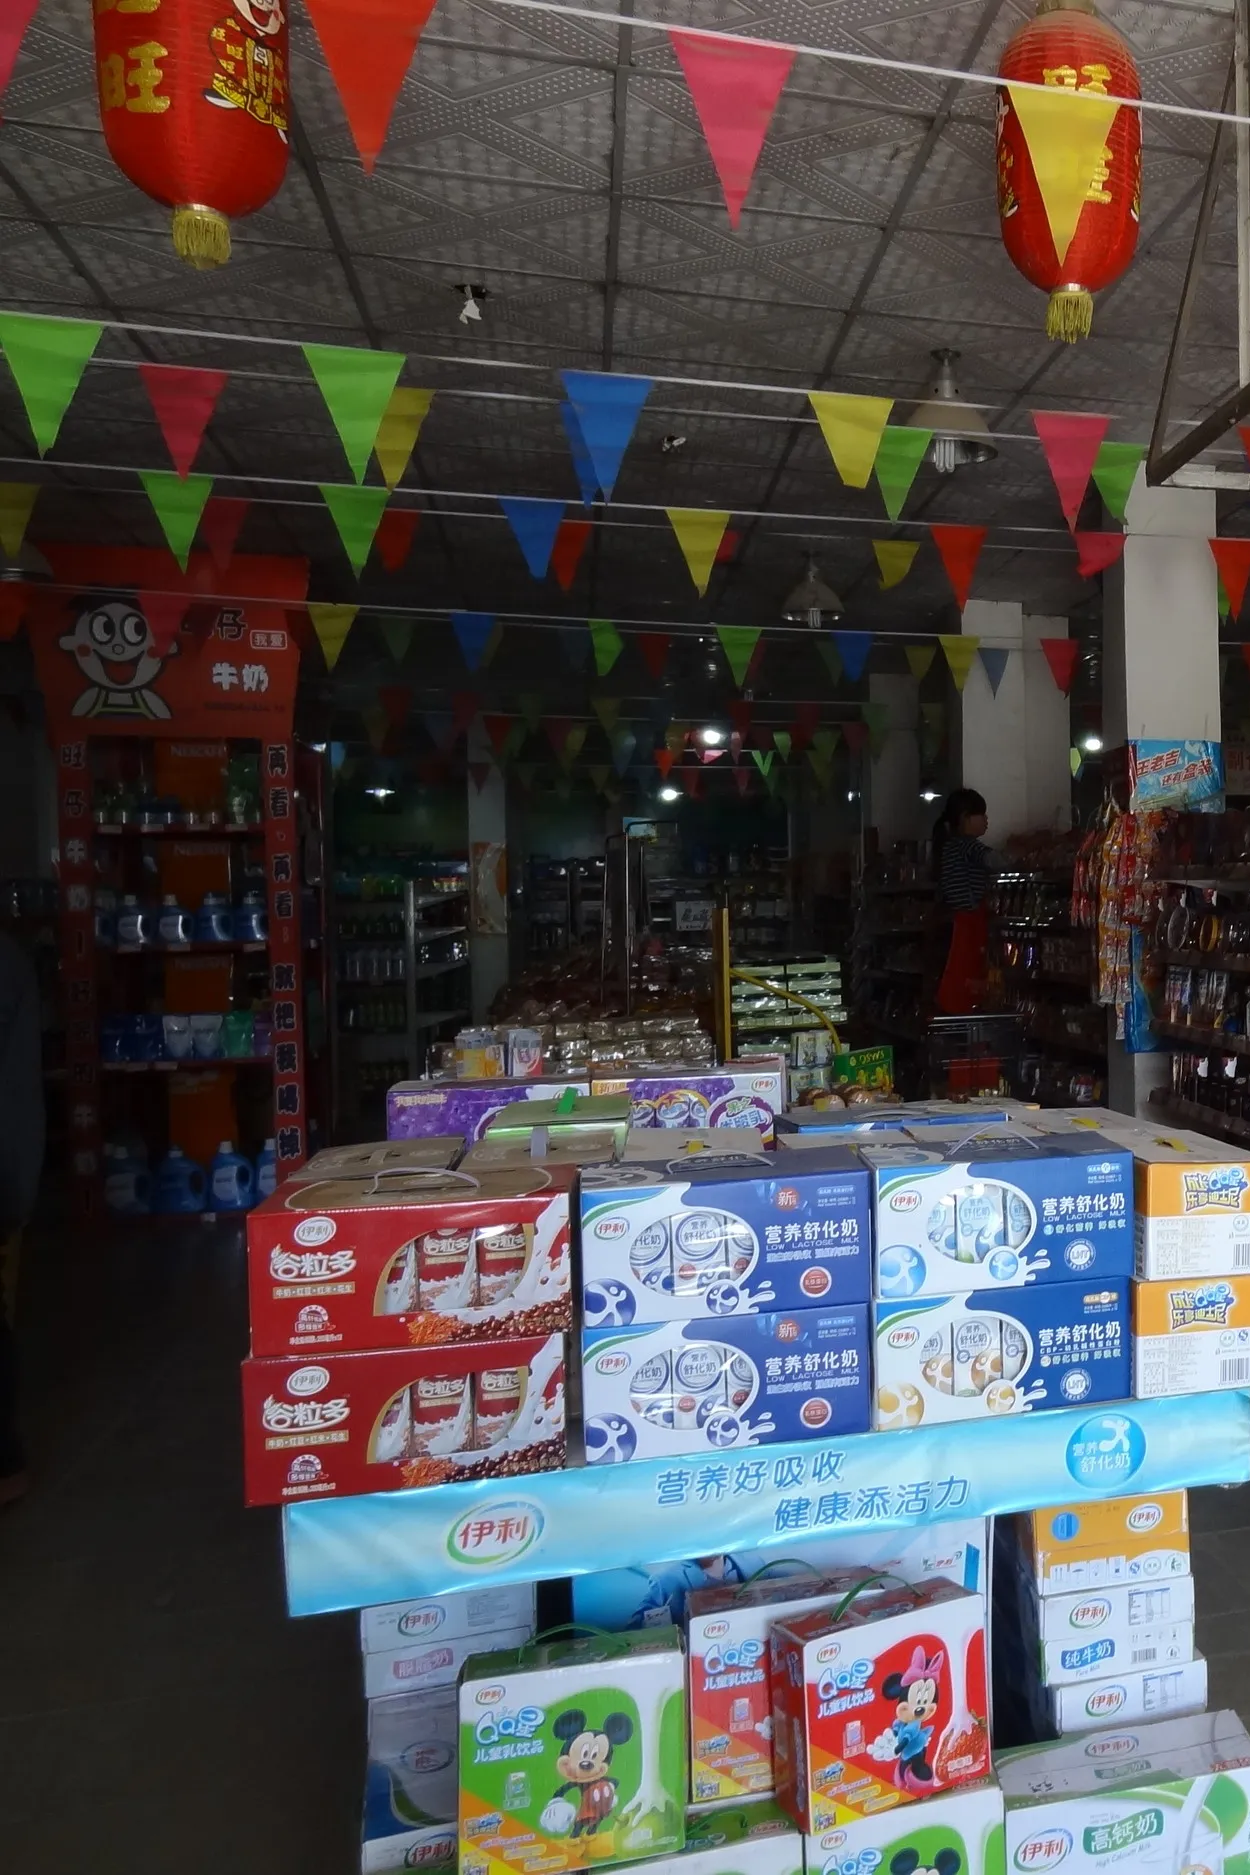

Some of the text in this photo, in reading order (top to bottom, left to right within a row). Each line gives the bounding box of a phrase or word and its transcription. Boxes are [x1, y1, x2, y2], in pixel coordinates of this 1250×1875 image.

[212, 663, 268, 692] 牛奶
[1136, 748, 1181, 778] 王老吉
[894, 1196, 917, 1206] 伊利
[1042, 1192, 1125, 1216] 营养舒化奶
[1066, 1211, 1103, 1221] LACTOSE
[301, 1224, 330, 1236] 伊利
[598, 1222, 625, 1235] 伊利
[765, 1218, 859, 1244] 营养舒化奶
[766, 1236, 860, 1252] LOW LACTOSE MILK
[270, 1244, 357, 1282] 谷粒多
[891, 1332, 915, 1342] 伊利
[1039, 1321, 1121, 1346] 营养舒化奶
[600, 1357, 626, 1370] 伊利
[684, 1361, 716, 1376] 舒化奶
[765, 1349, 859, 1376] 营养舒化奶
[292, 1373, 325, 1388] 伊利
[792, 1370, 834, 1380] LACTOSE
[841, 1367, 860, 1375] MILK
[262, 1394, 350, 1433] 谷粒多
[1072, 1442, 1100, 1457] 营养
[1081, 1452, 1132, 1474] 舒化奶
[656, 1448, 846, 1506] 营养好吸收
[774, 1475, 970, 1533] 健康添活力
[1132, 1511, 1155, 1523] 伊利
[459, 1516, 528, 1549] 伊利
[403, 1610, 438, 1629] 伊利
[1073, 1606, 1106, 1622] 伊利
[707, 1623, 727, 1636] 伊利
[820, 1647, 838, 1659] 伊利
[1064, 1640, 1112, 1668] 纯牛奶
[479, 1690, 502, 1700] 伊利
[1089, 1692, 1121, 1709] 伊利
[476, 1705, 545, 1746] QQ星
[1091, 1738, 1131, 1754] 伊利
[823, 1834, 844, 1848] 伊利
[1090, 1812, 1158, 1853] 高钙奶
[411, 1840, 457, 1864] 伊利
[1021, 1838, 1065, 1864] 伊利
